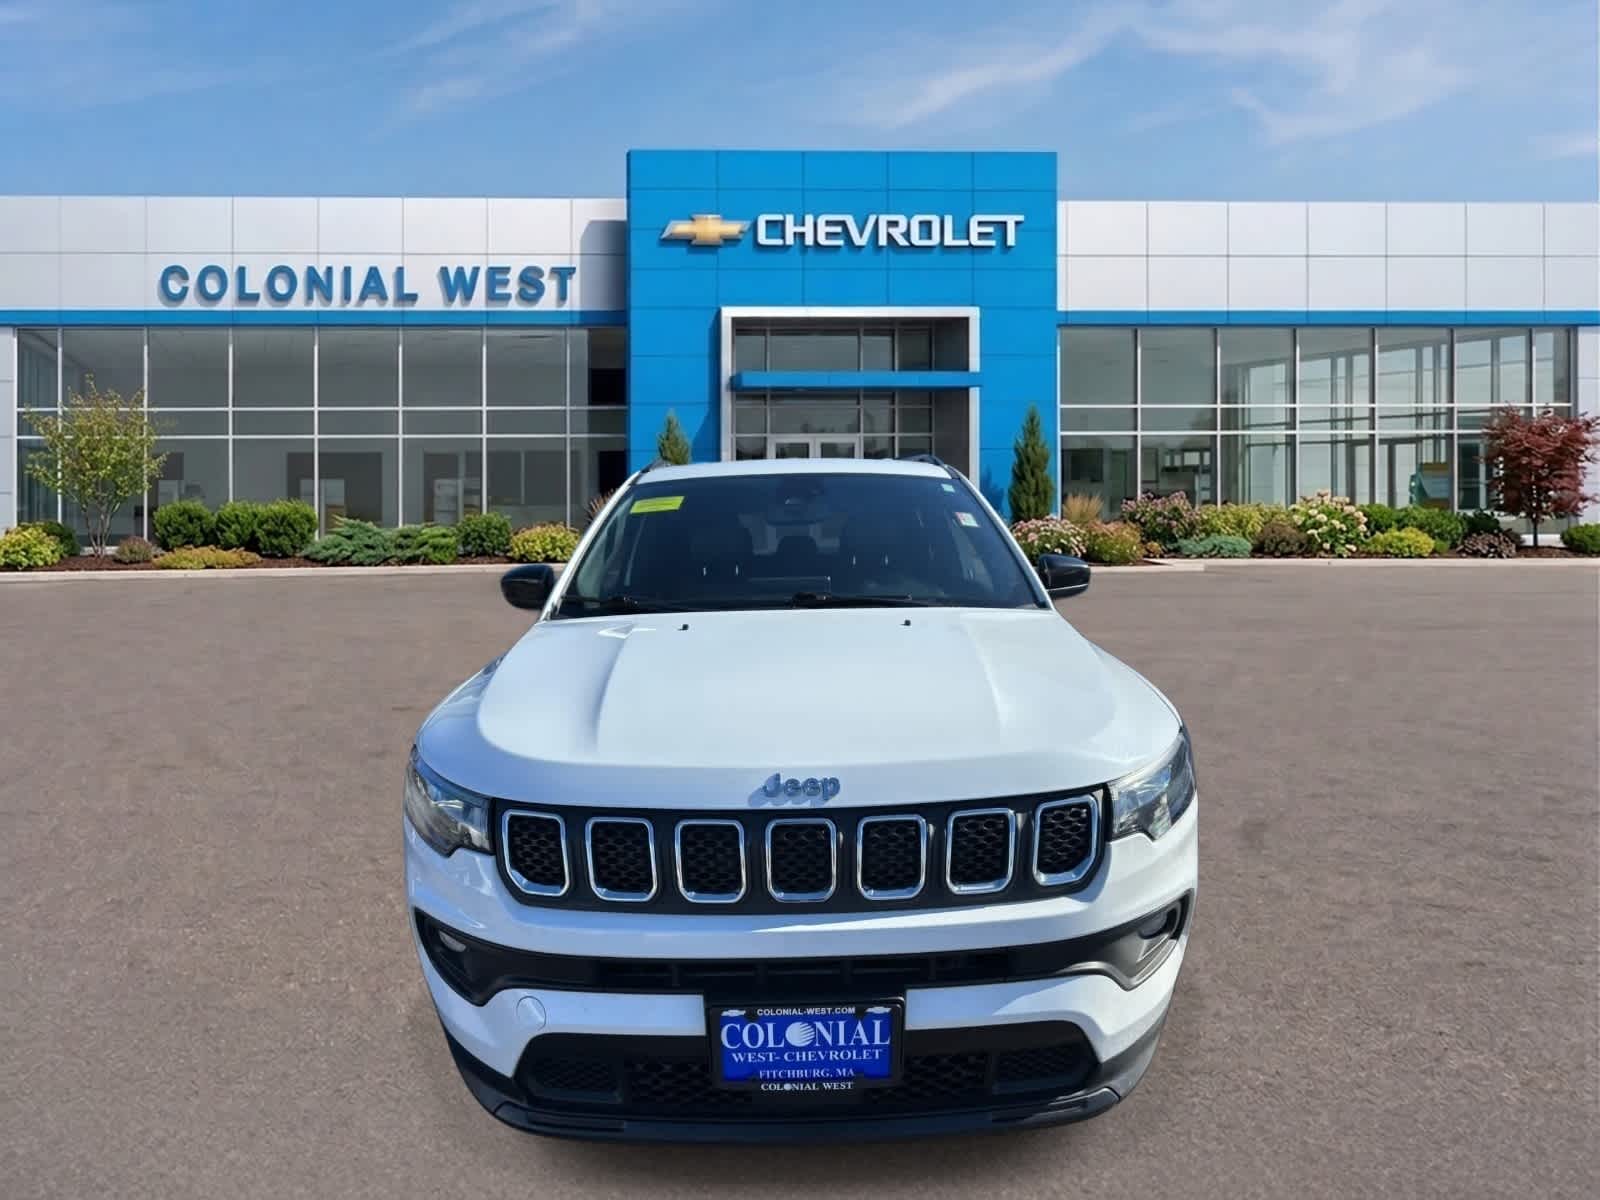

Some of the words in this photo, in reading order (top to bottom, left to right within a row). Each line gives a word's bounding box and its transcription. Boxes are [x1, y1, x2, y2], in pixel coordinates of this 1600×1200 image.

[757, 214, 1025, 247] CHEVROLET
[160, 265, 418, 303] COLONIAL
[440, 265, 576, 303] WEST
[763, 773, 840, 800] Jeep
[757, 1007, 855, 1016] COLONIAL-WEST.COM
[721, 1020, 890, 1049] COLONIAL
[784, 1049, 882, 1062] CHEVROLET
[836, 1068, 854, 1077] MA
[760, 1083, 818, 1091] COLONIAL
[823, 1082, 853, 1090] WEST
